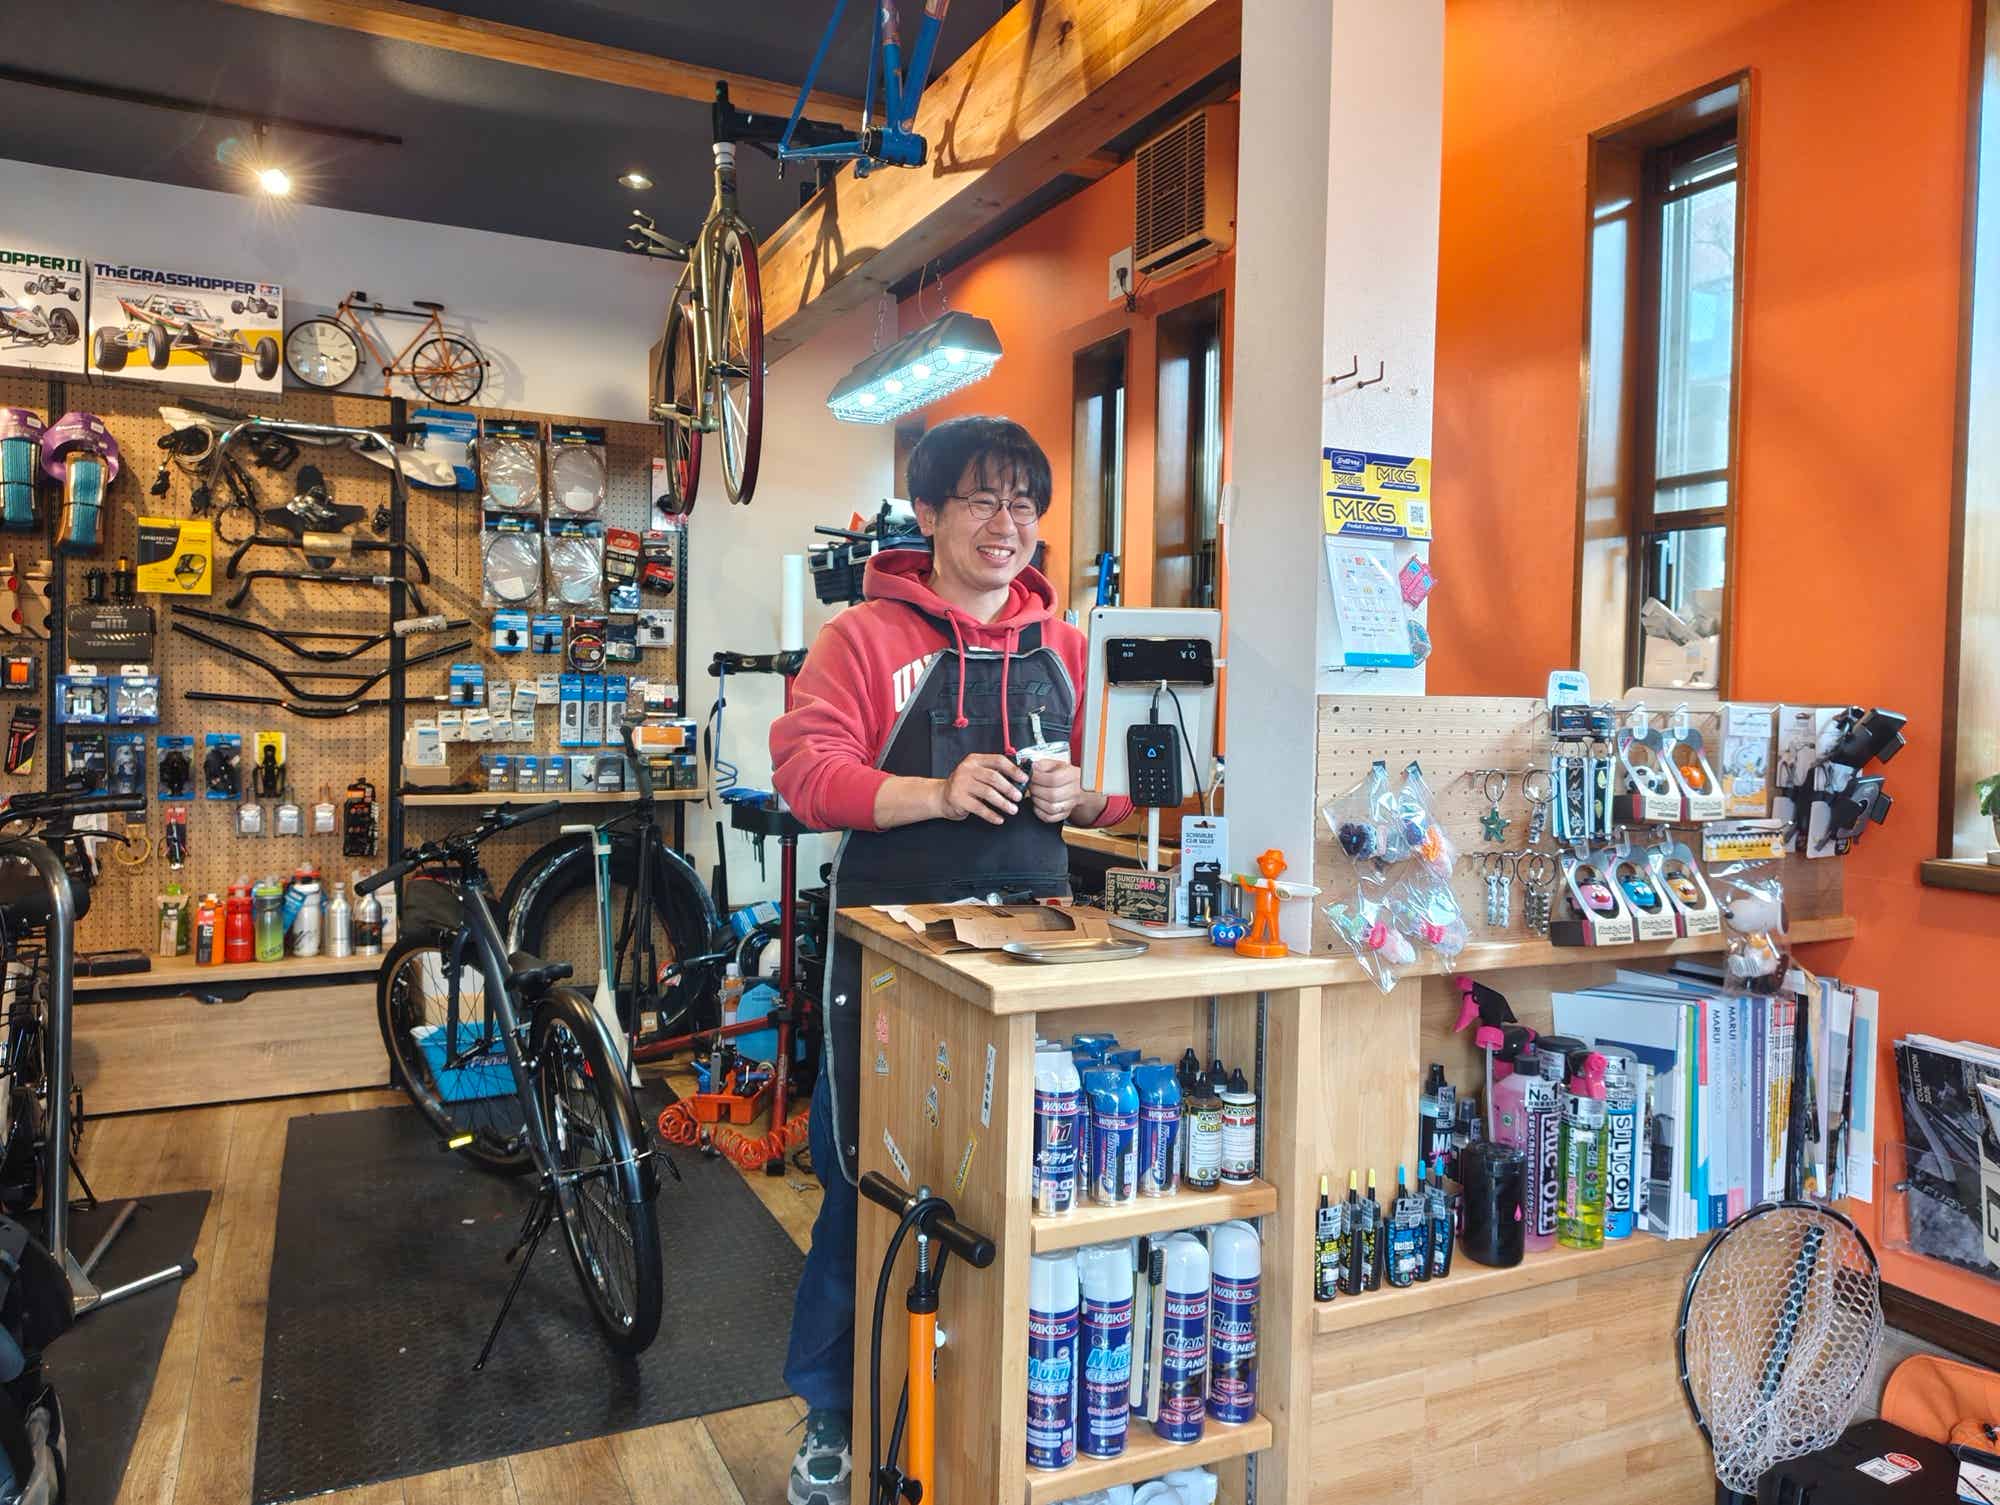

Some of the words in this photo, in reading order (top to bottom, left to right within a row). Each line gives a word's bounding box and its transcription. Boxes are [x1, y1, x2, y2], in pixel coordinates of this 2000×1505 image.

[95, 264, 128, 278] The
[129, 268, 256, 294] GRASSHOPPER
[1376, 467, 1417, 484] MKS
[1333, 498, 1397, 524] MKS
[1713, 1009, 1721, 1044] MARUI
[1728, 1005, 1737, 1040] MARUI
[1911, 1054, 1924, 1103] COLLECTION
